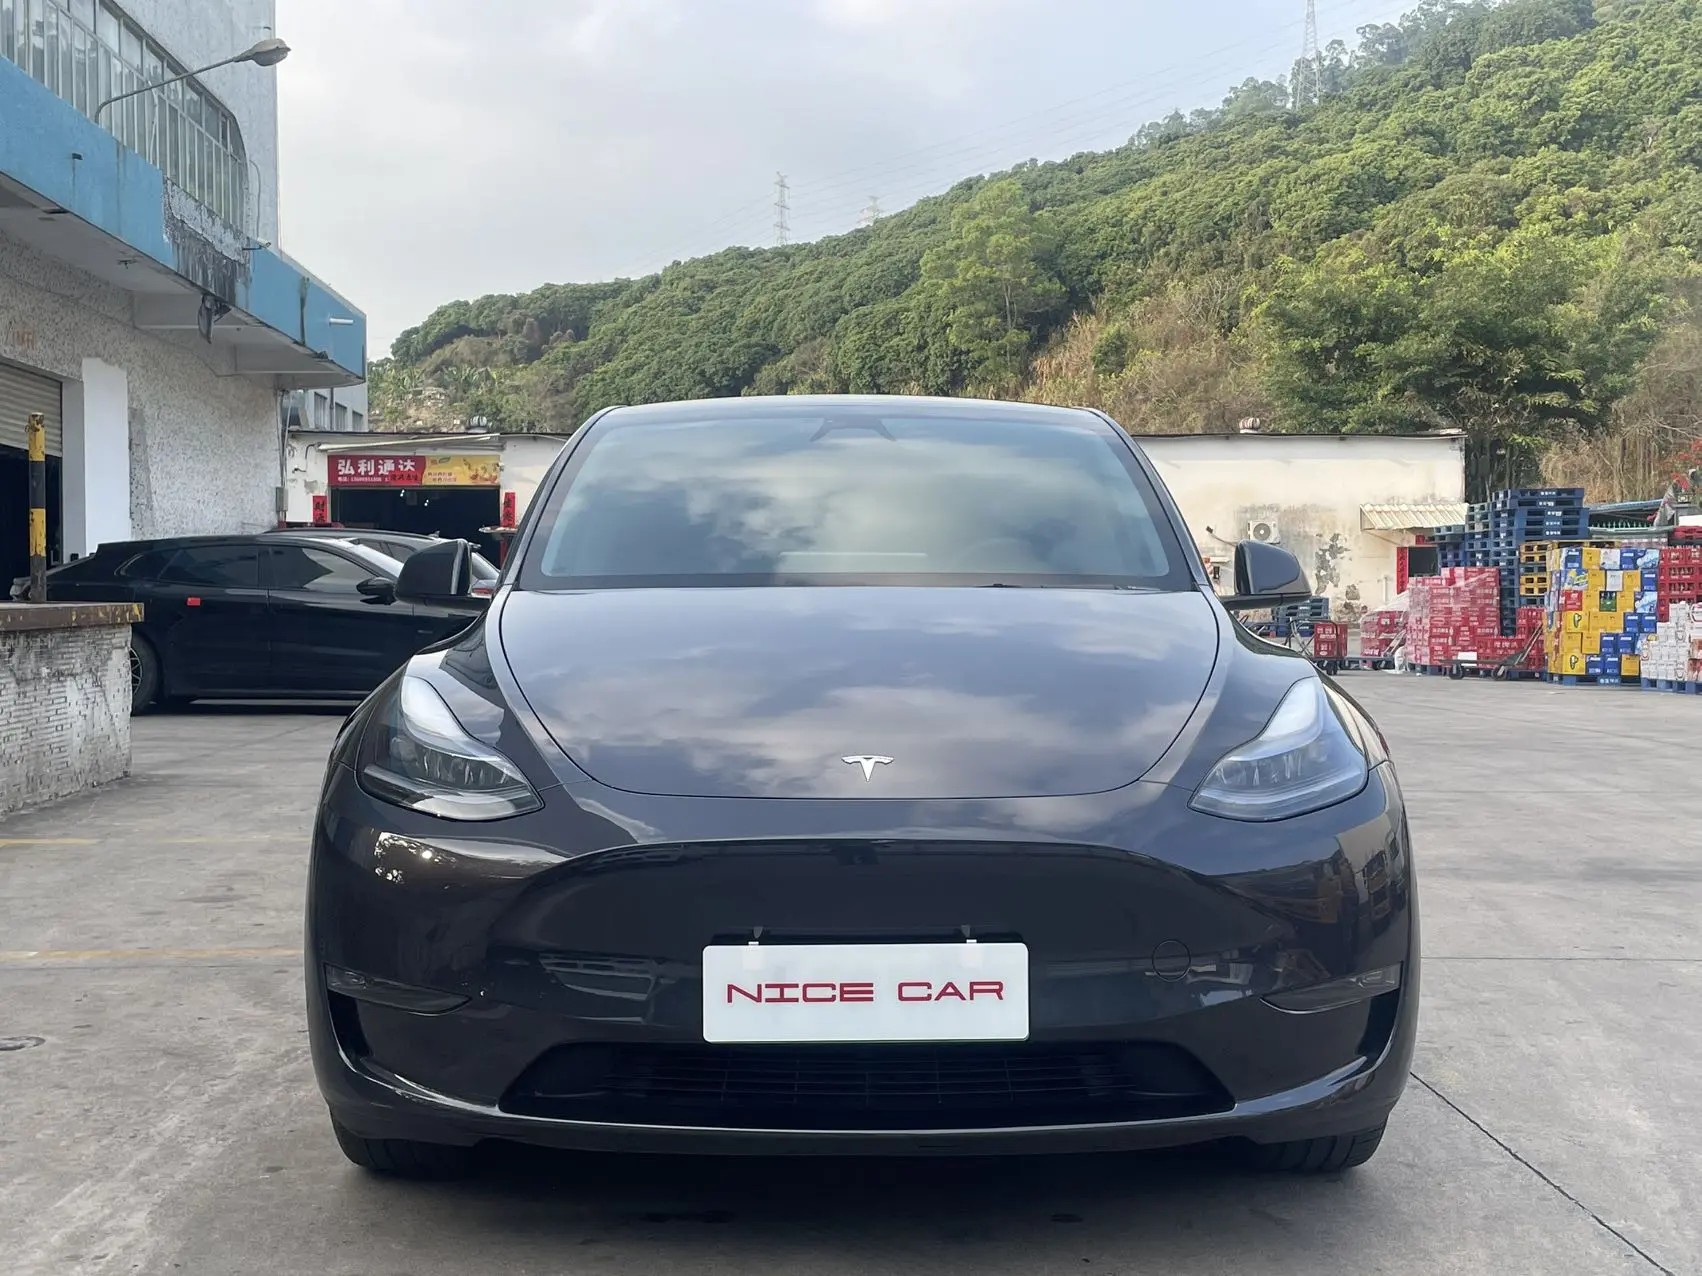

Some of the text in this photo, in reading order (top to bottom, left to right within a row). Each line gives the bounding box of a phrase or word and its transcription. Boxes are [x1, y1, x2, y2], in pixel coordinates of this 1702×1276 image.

[337, 459, 415, 476] 弘利通达
[727, 981, 1004, 1003] NICE CAR
